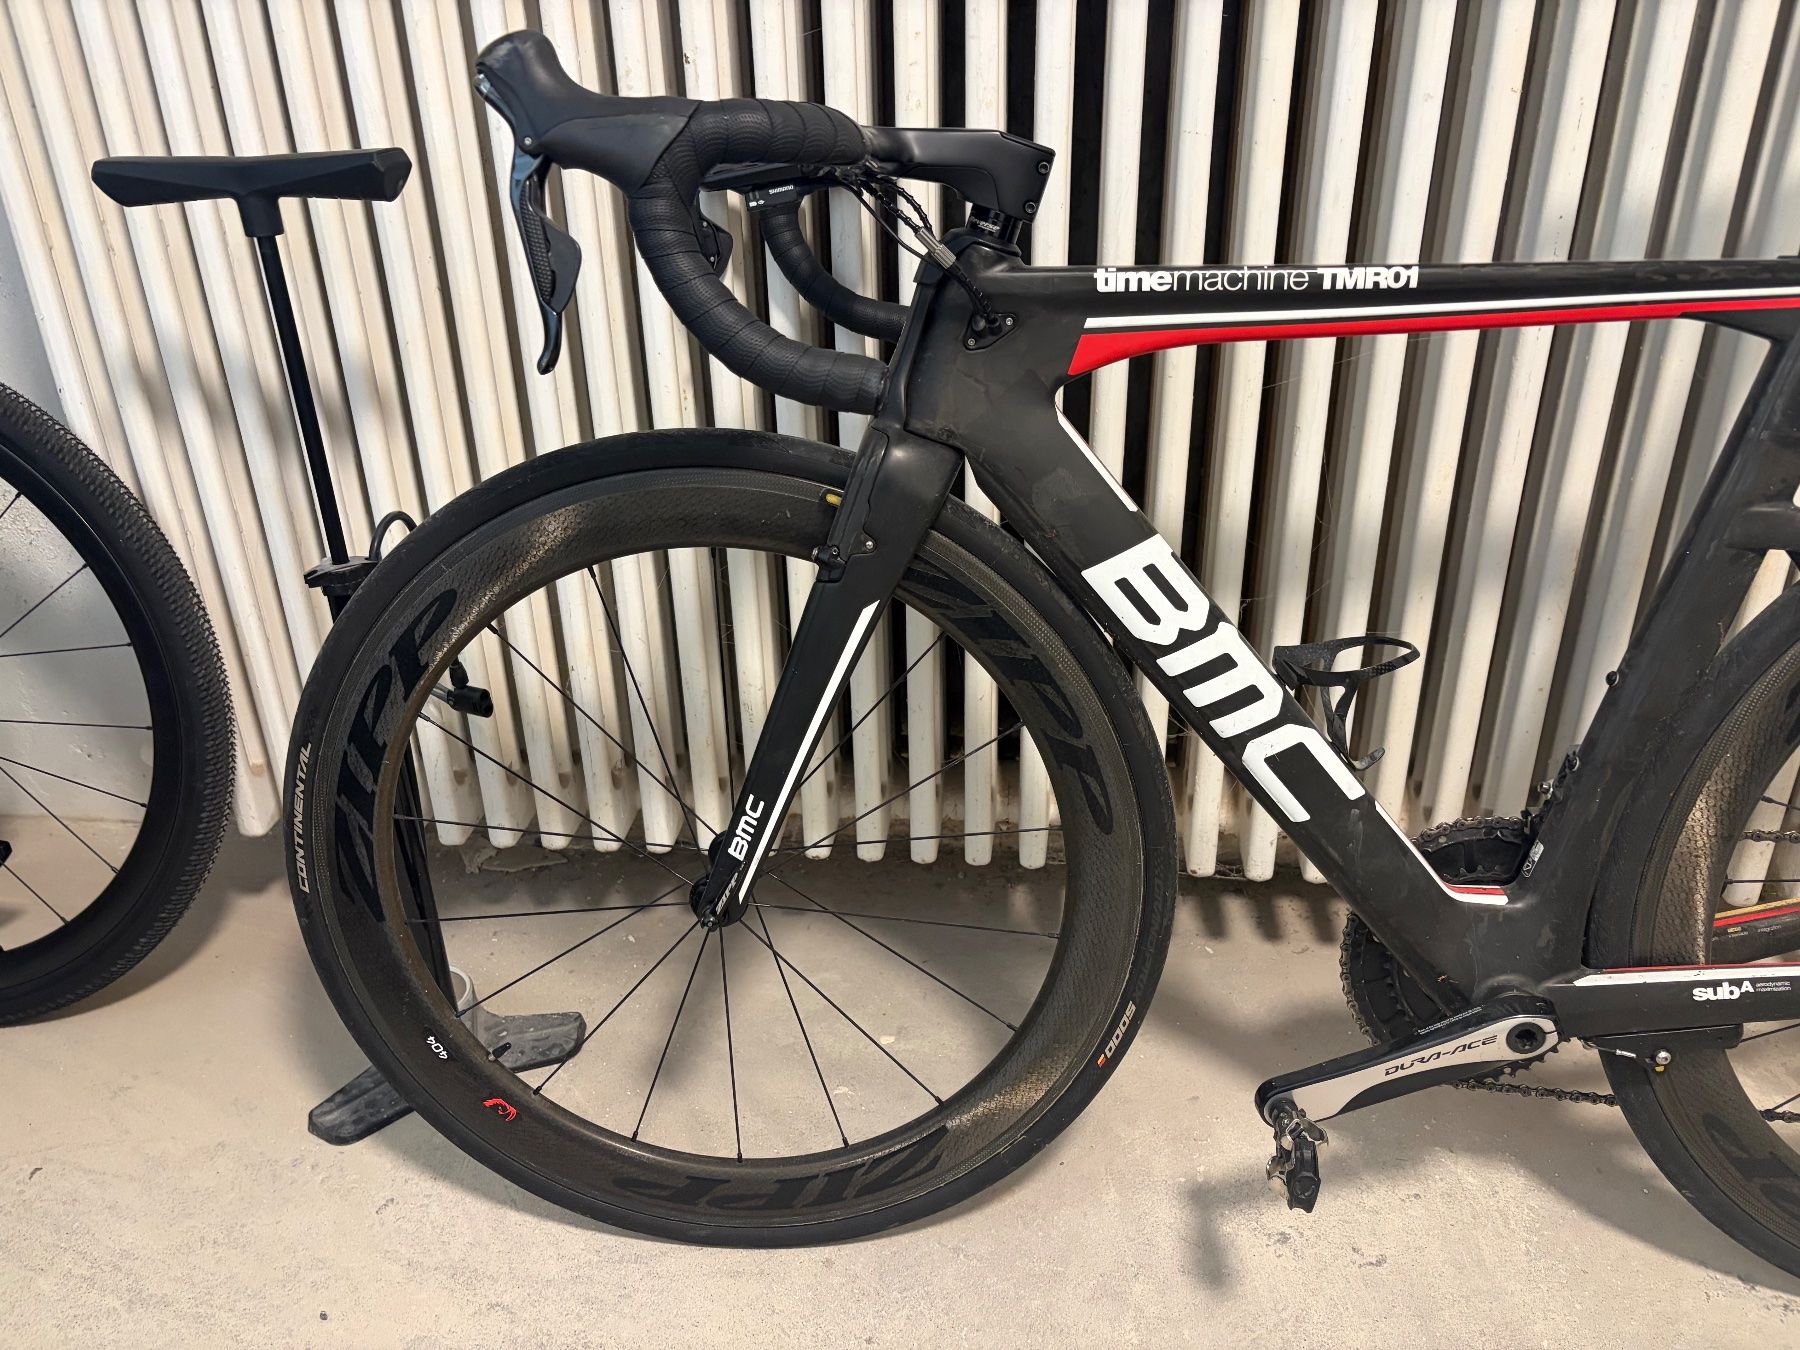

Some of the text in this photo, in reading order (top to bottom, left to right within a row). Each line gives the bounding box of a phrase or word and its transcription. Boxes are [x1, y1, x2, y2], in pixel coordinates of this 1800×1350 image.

[1094, 265, 1420, 293] timemachine TMR01
[1081, 533, 1366, 823] BMC
[334, 588, 457, 922] ZIPP
[293, 741, 311, 894] CONTINENTAL
[728, 793, 765, 862] BMC
[426, 1035, 449, 1060] 404
[1104, 1000, 1137, 1059] 5000
[1384, 1035, 1498, 1077] DURA-ACE
[611, 1125, 950, 1210] ZIPP
